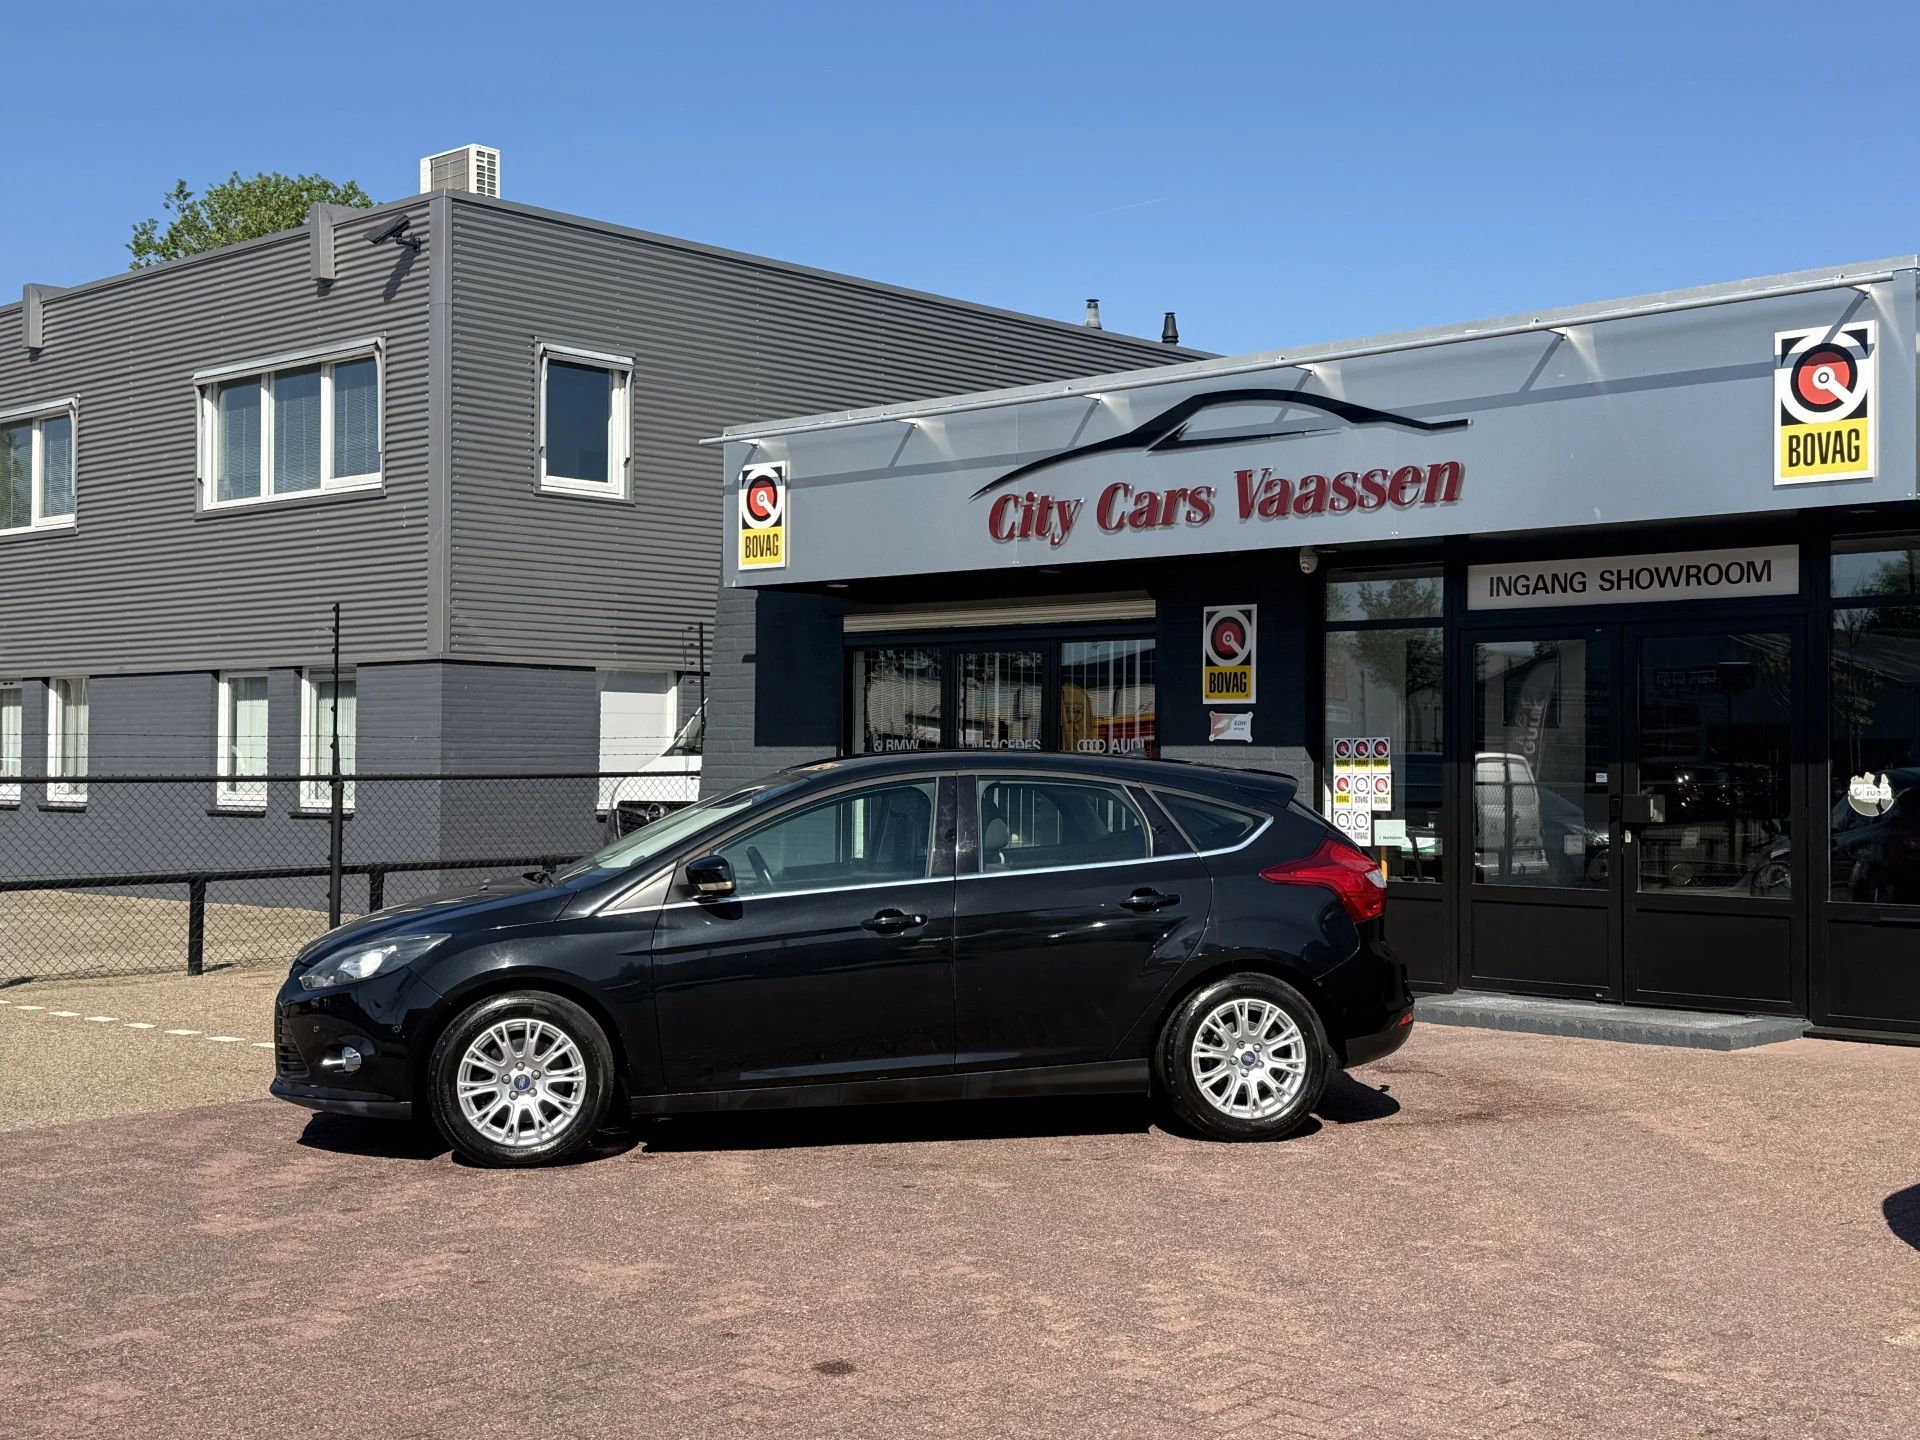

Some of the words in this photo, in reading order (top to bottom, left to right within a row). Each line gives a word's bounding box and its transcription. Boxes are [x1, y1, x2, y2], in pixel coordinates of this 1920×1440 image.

[1788, 428, 1860, 467] BOVAG
[988, 492, 1085, 547] City
[1096, 481, 1216, 530] Cars
[1233, 460, 1464, 521] Vaassen
[745, 533, 779, 558] BOVAG
[1489, 571, 1587, 598] INGANG
[1598, 559, 1772, 592] SHOWROOM
[1209, 671, 1247, 694] BOVAG
[886, 739, 920, 750] BMW
